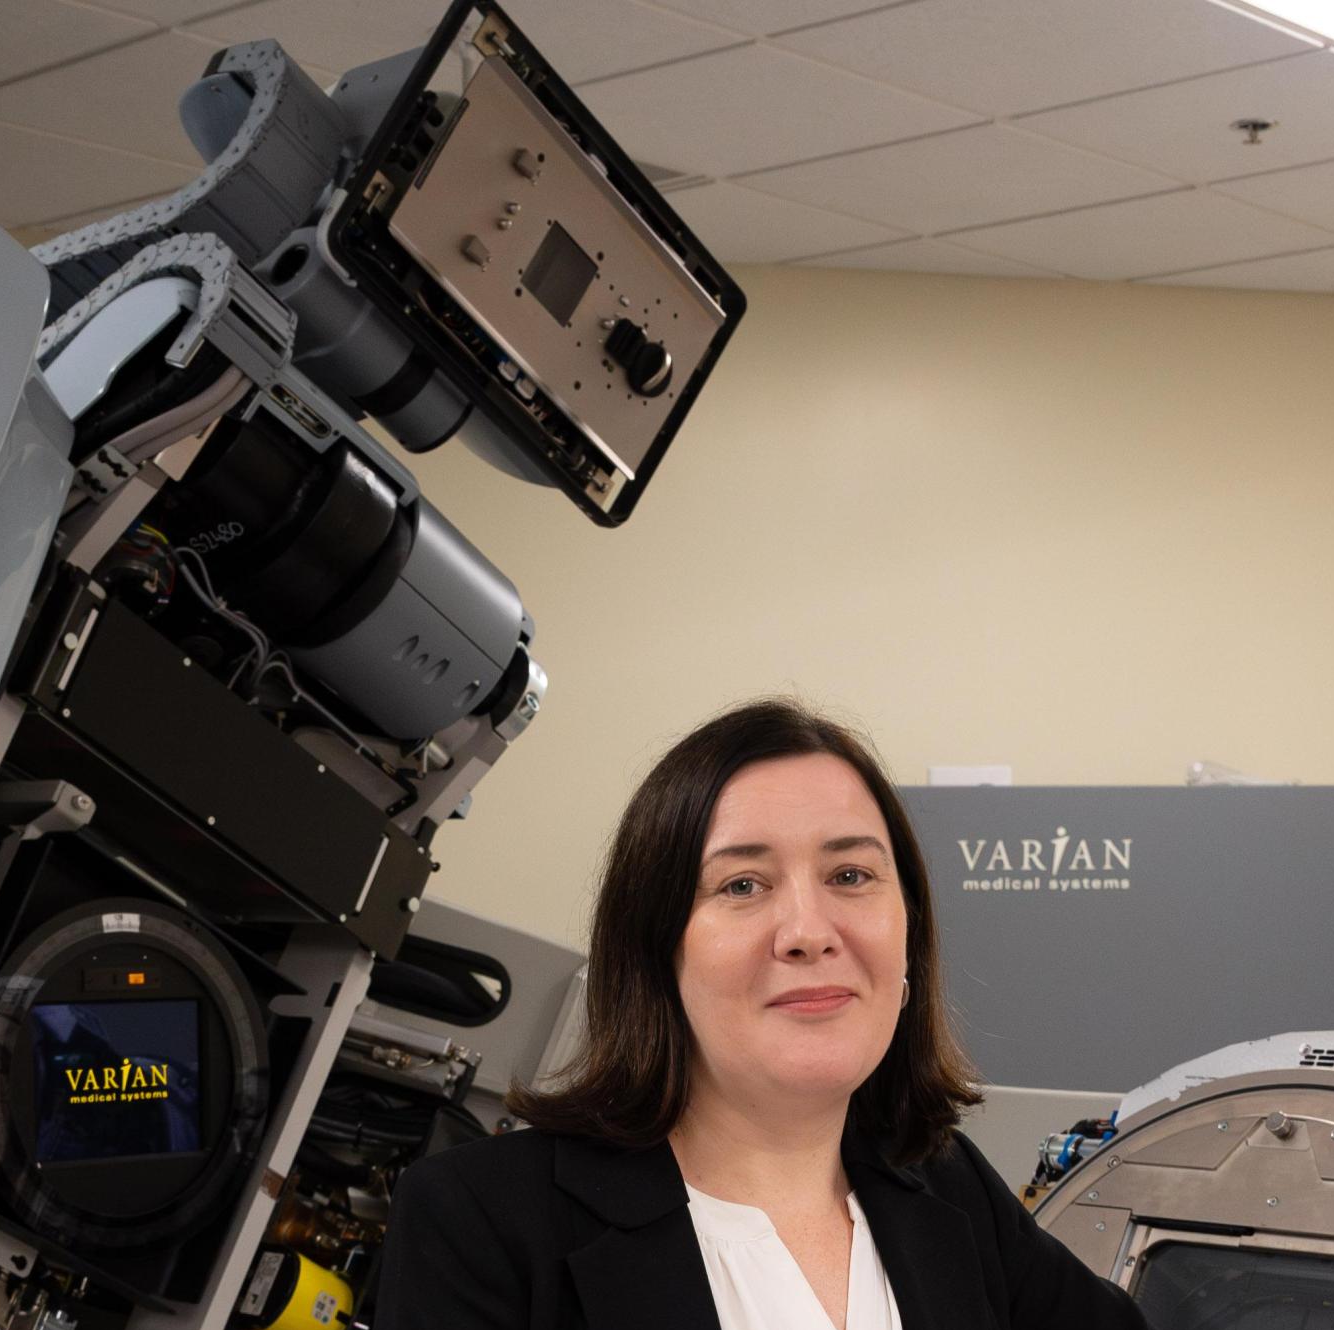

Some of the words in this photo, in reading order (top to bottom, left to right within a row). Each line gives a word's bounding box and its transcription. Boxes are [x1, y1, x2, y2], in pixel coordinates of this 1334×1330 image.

[957, 826, 1133, 876] VARIAN
[963, 875, 1041, 891] medical
[1048, 876, 1131, 892] systems
[65, 1057, 169, 1092] VARIAN
[70, 1093, 116, 1104] medical
[121, 1090, 169, 1102] systems
